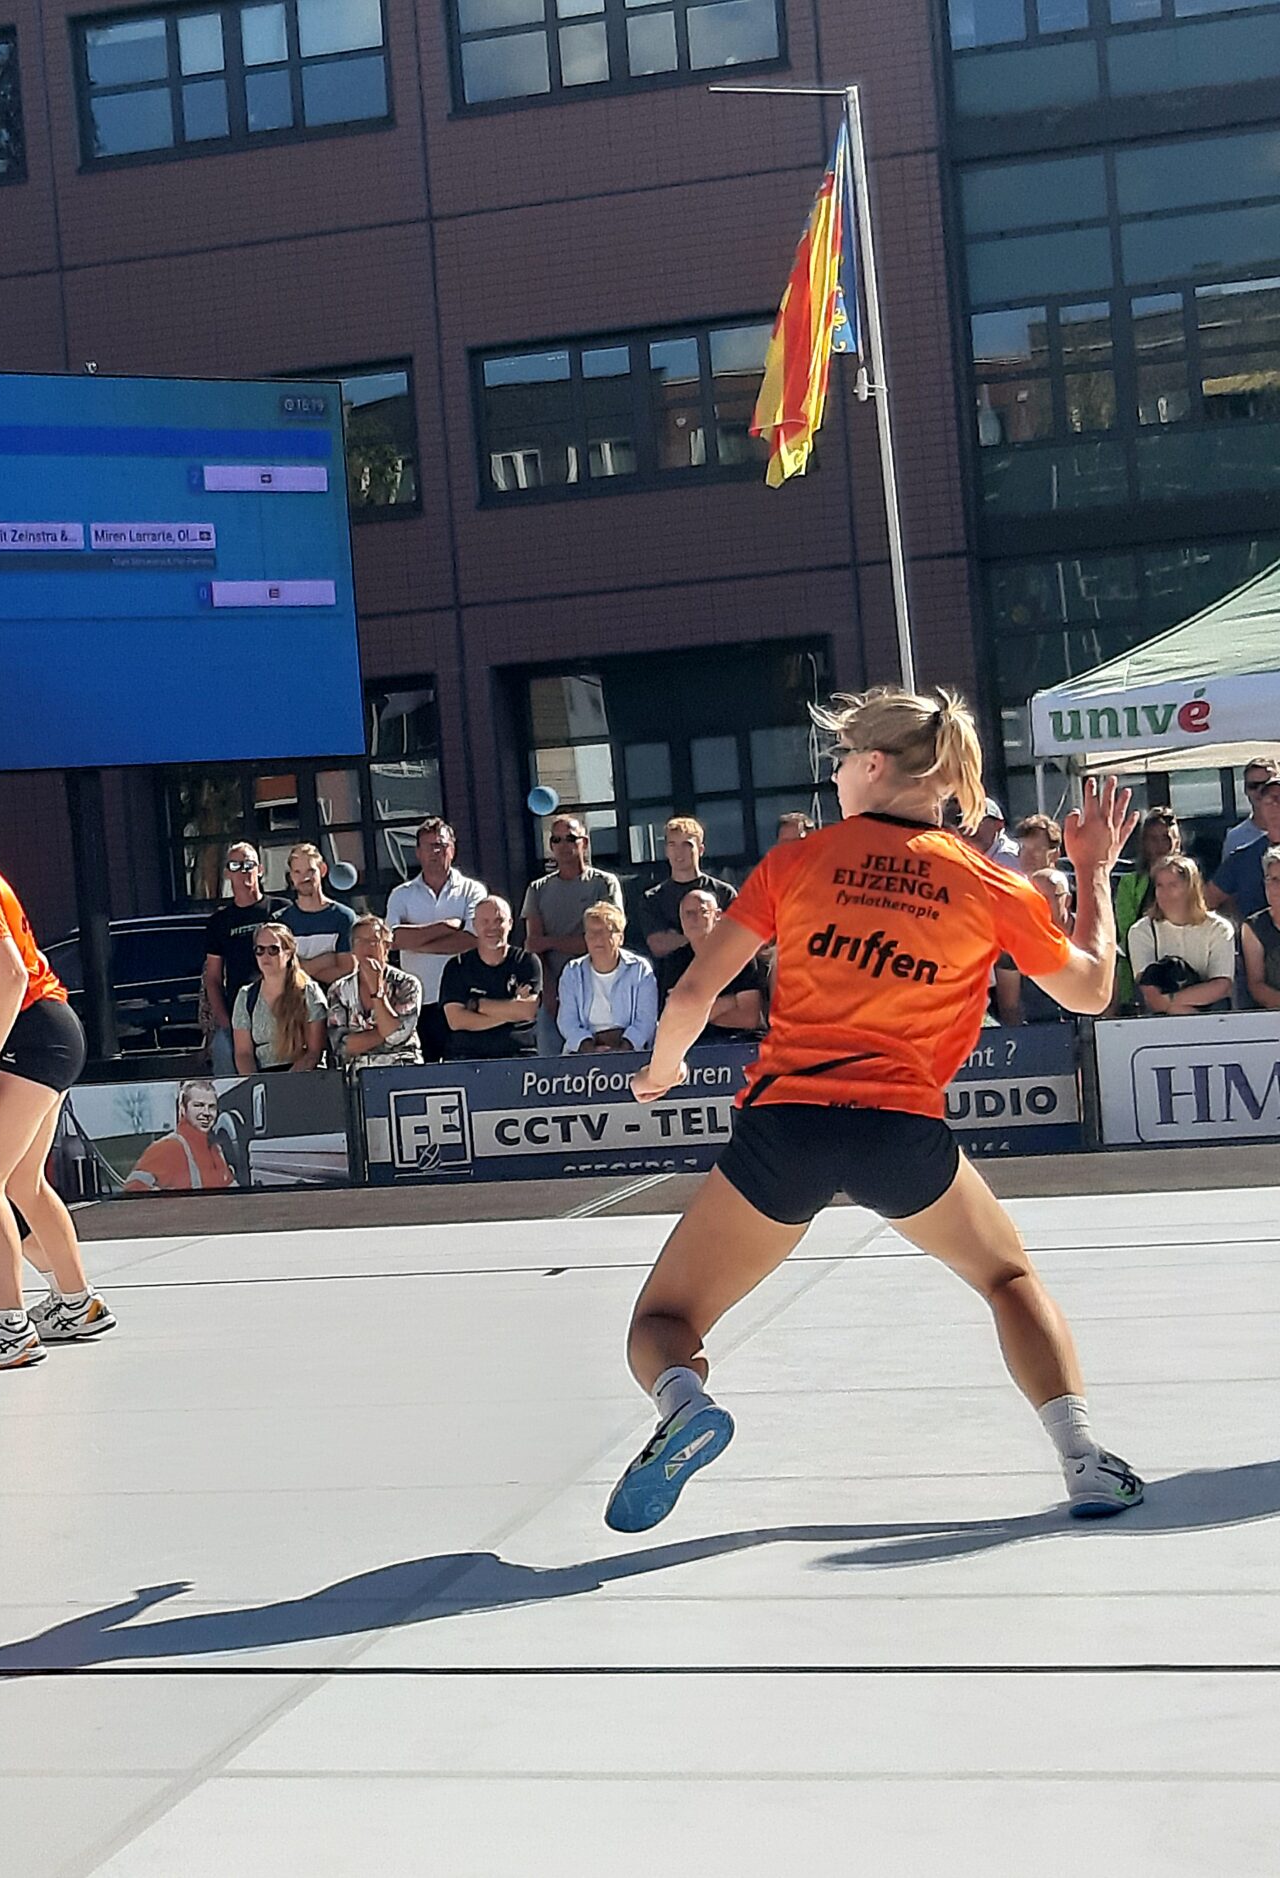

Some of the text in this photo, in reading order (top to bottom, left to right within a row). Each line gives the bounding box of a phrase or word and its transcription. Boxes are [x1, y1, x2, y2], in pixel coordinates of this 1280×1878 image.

[10, 529, 58, 543] Zeinstra
[94, 529, 125, 543] Miren
[1048, 687, 1211, 743] univé
[860, 854, 932, 879] JELLE
[832, 868, 951, 905] EIJZENGA
[836, 889, 940, 921] fysiotherapie
[807, 923, 939, 986] driffen
[957, 1046, 995, 1068] nt
[1005, 1040, 1017, 1066] ?
[494, 1112, 609, 1146] CCTV
[651, 1106, 730, 1137] TEL
